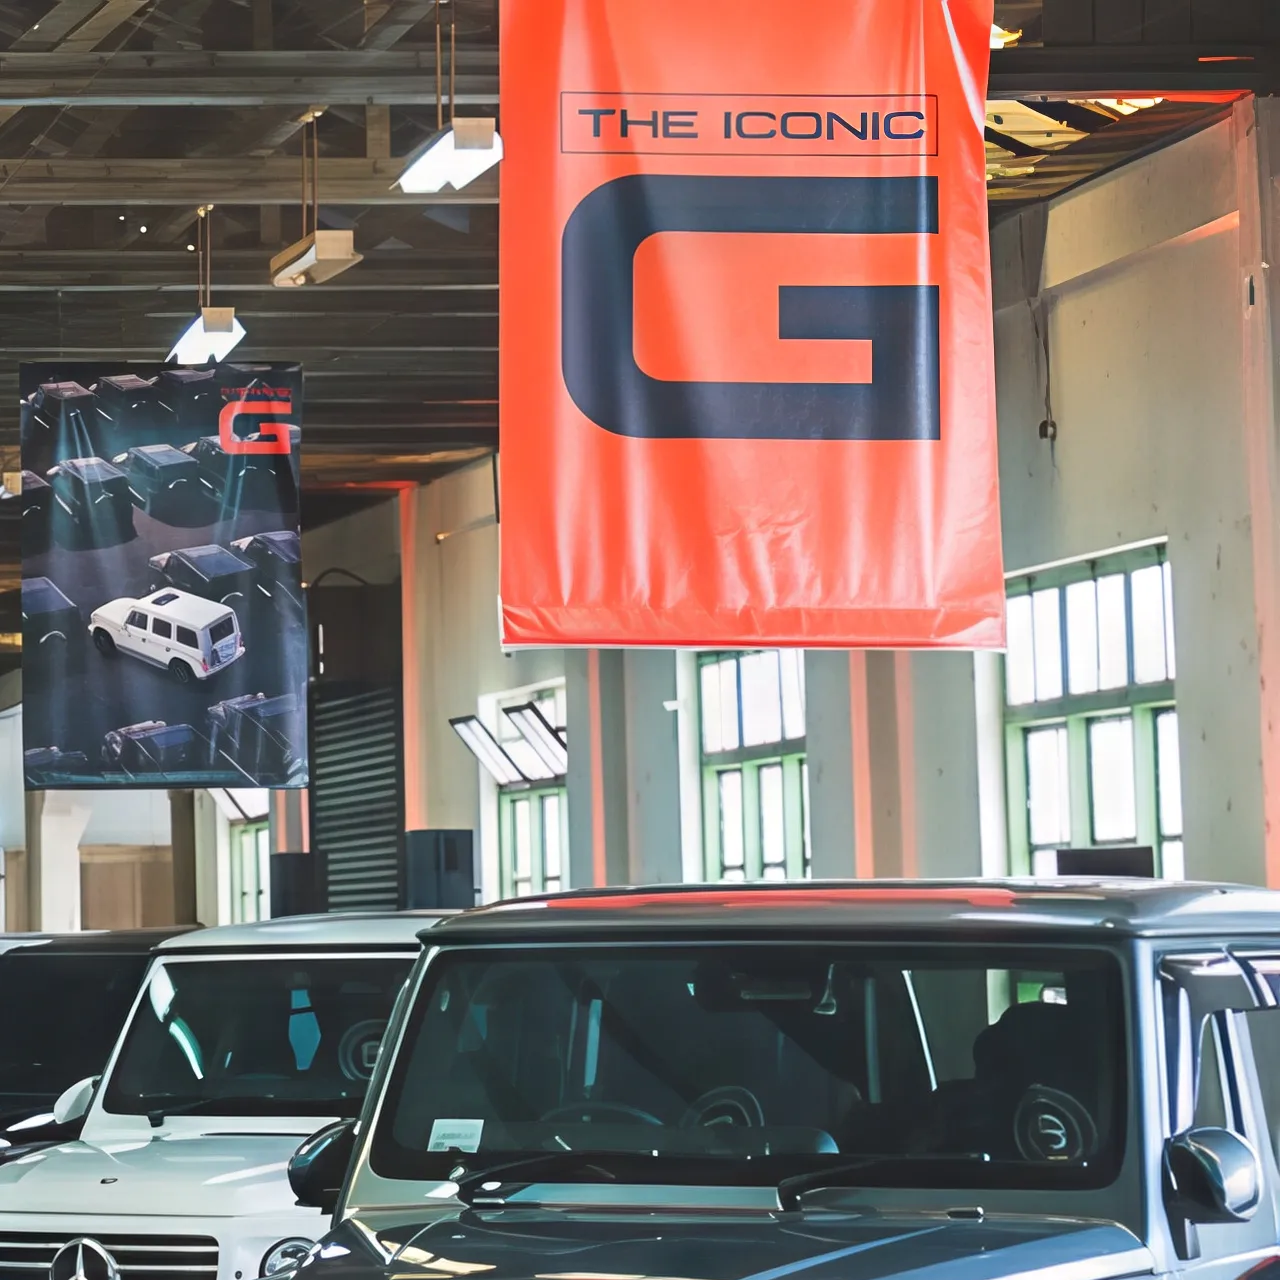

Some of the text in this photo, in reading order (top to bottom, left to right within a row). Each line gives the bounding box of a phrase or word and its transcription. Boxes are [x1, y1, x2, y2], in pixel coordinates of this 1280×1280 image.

[578, 108, 925, 141] THE ICONIC
[561, 174, 940, 441] G
[218, 401, 291, 455] G
